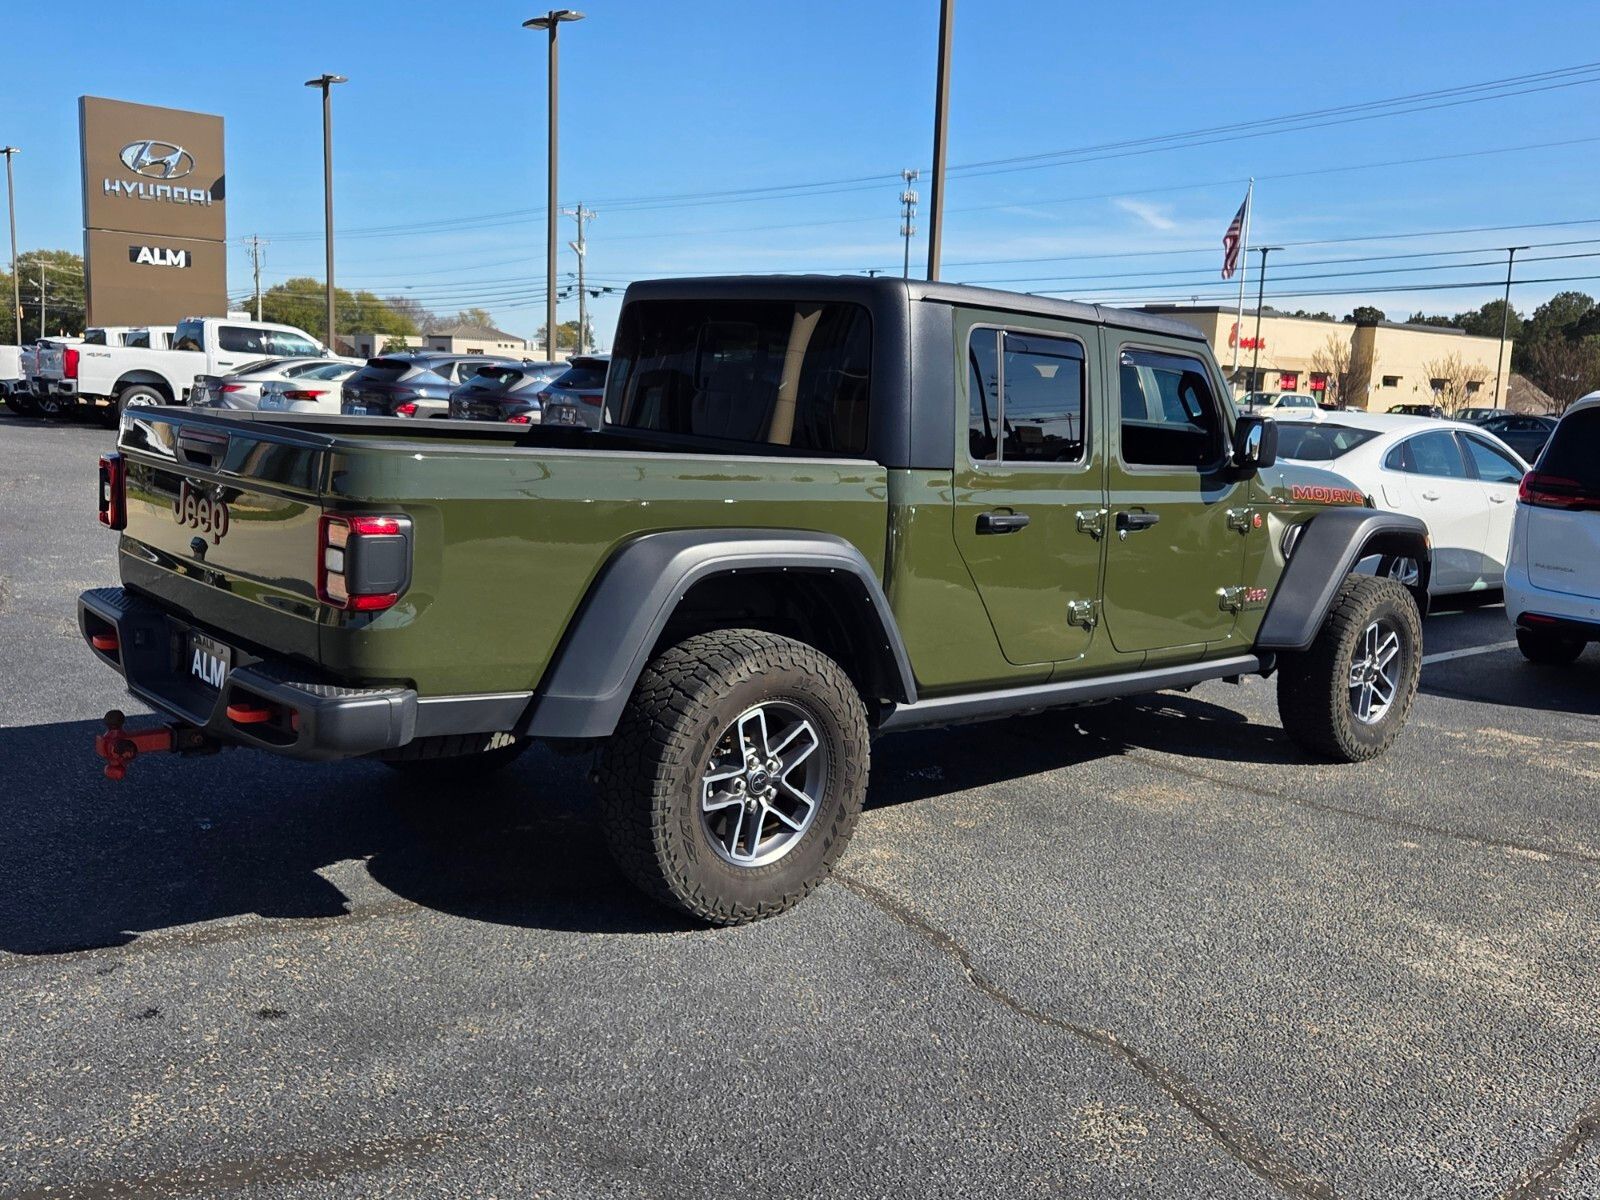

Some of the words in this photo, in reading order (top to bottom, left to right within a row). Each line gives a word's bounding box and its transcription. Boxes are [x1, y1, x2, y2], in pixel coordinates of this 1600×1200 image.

[103, 178, 213, 206] HYUNDAI
[135, 246, 186, 268] ALM
[1291, 484, 1364, 504] MOJAVE
[171, 480, 229, 545] Jeep
[192, 648, 226, 691] ALM
